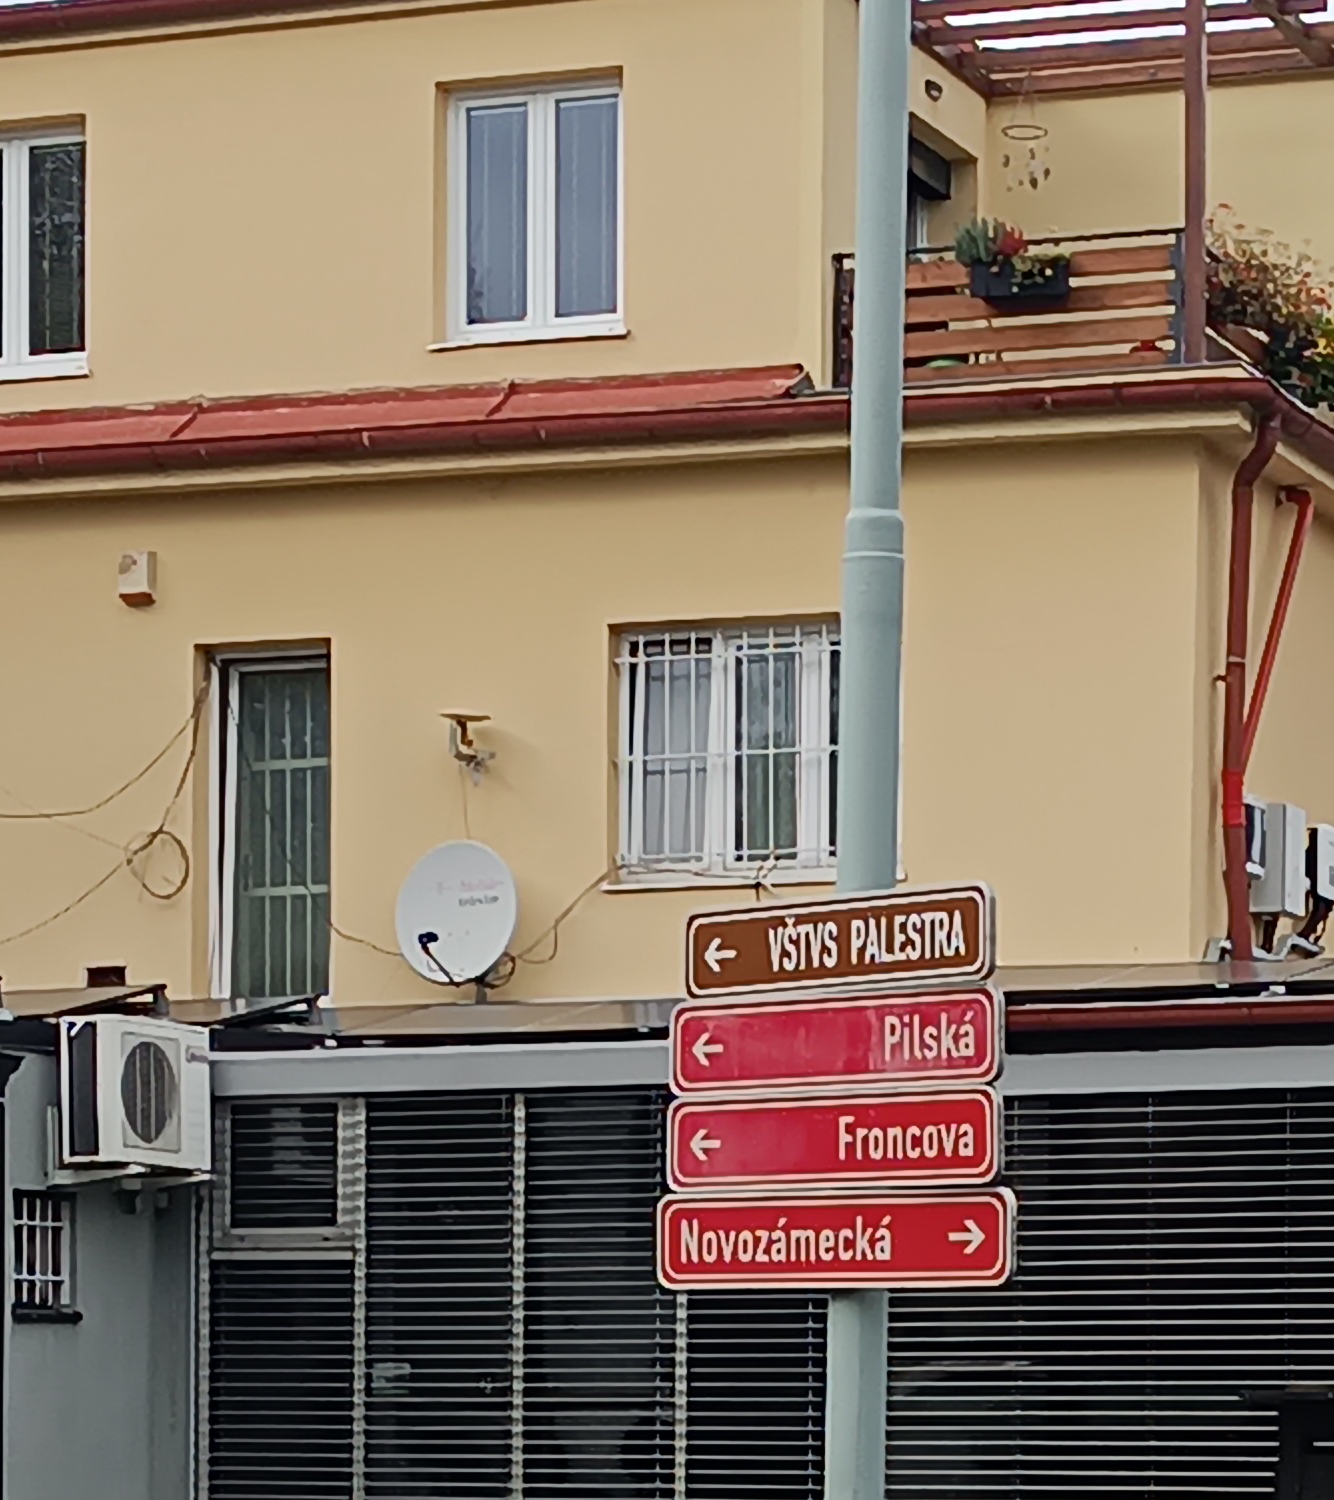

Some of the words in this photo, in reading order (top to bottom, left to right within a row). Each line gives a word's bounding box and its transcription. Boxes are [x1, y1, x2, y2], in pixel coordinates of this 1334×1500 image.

[768, 914, 838, 973] VŠTVS
[851, 909, 966, 966] PALESTRA
[884, 1010, 976, 1062] Pilská
[837, 1115, 975, 1161] Froncova
[679, 1214, 892, 1264] Novozámecká
